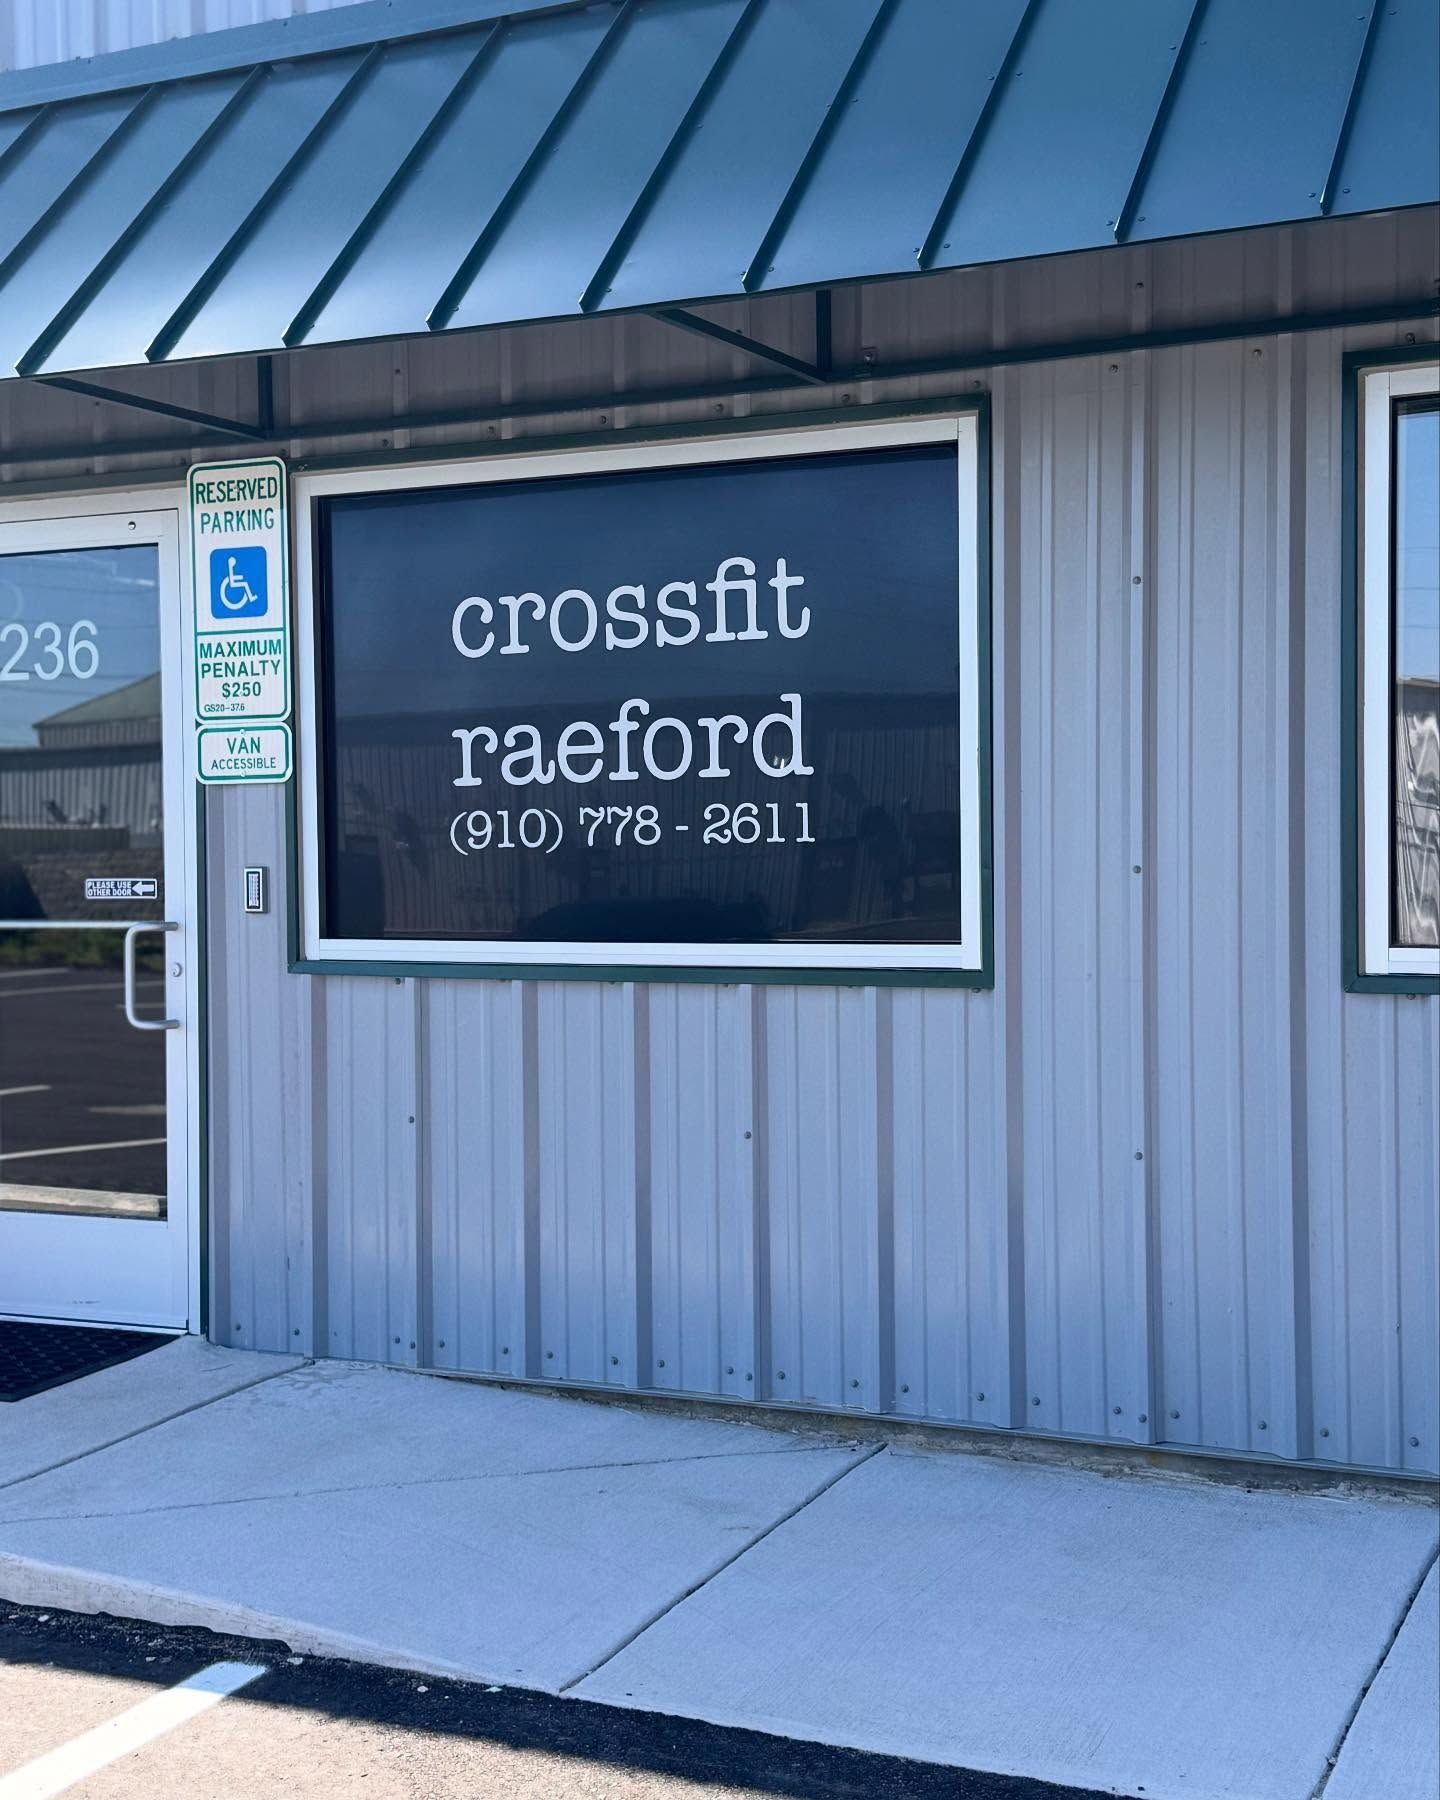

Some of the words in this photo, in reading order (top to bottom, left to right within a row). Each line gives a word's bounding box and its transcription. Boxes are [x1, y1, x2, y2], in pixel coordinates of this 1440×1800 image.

[195, 477, 277, 504] RESERVED
[200, 507, 275, 534] PARKING
[452, 556, 811, 659] crossfit
[0, 620, 99, 681] 236
[199, 638, 282, 659] MAXIMUM
[201, 659, 281, 679] PENALTY
[222, 682, 261, 698] $250
[226, 736, 261, 755] VAN
[451, 693, 814, 787] raeford
[211, 757, 277, 770] ACCESSIBLE
[450, 809, 563, 855] (910)
[579, 805, 662, 847] 778
[703, 802, 815, 845] 2611
[87, 881, 115, 889] PLEASE
[117, 881, 132, 889] USE
[87, 888, 111, 896] OTHER
[112, 888, 132, 896] DOOR
